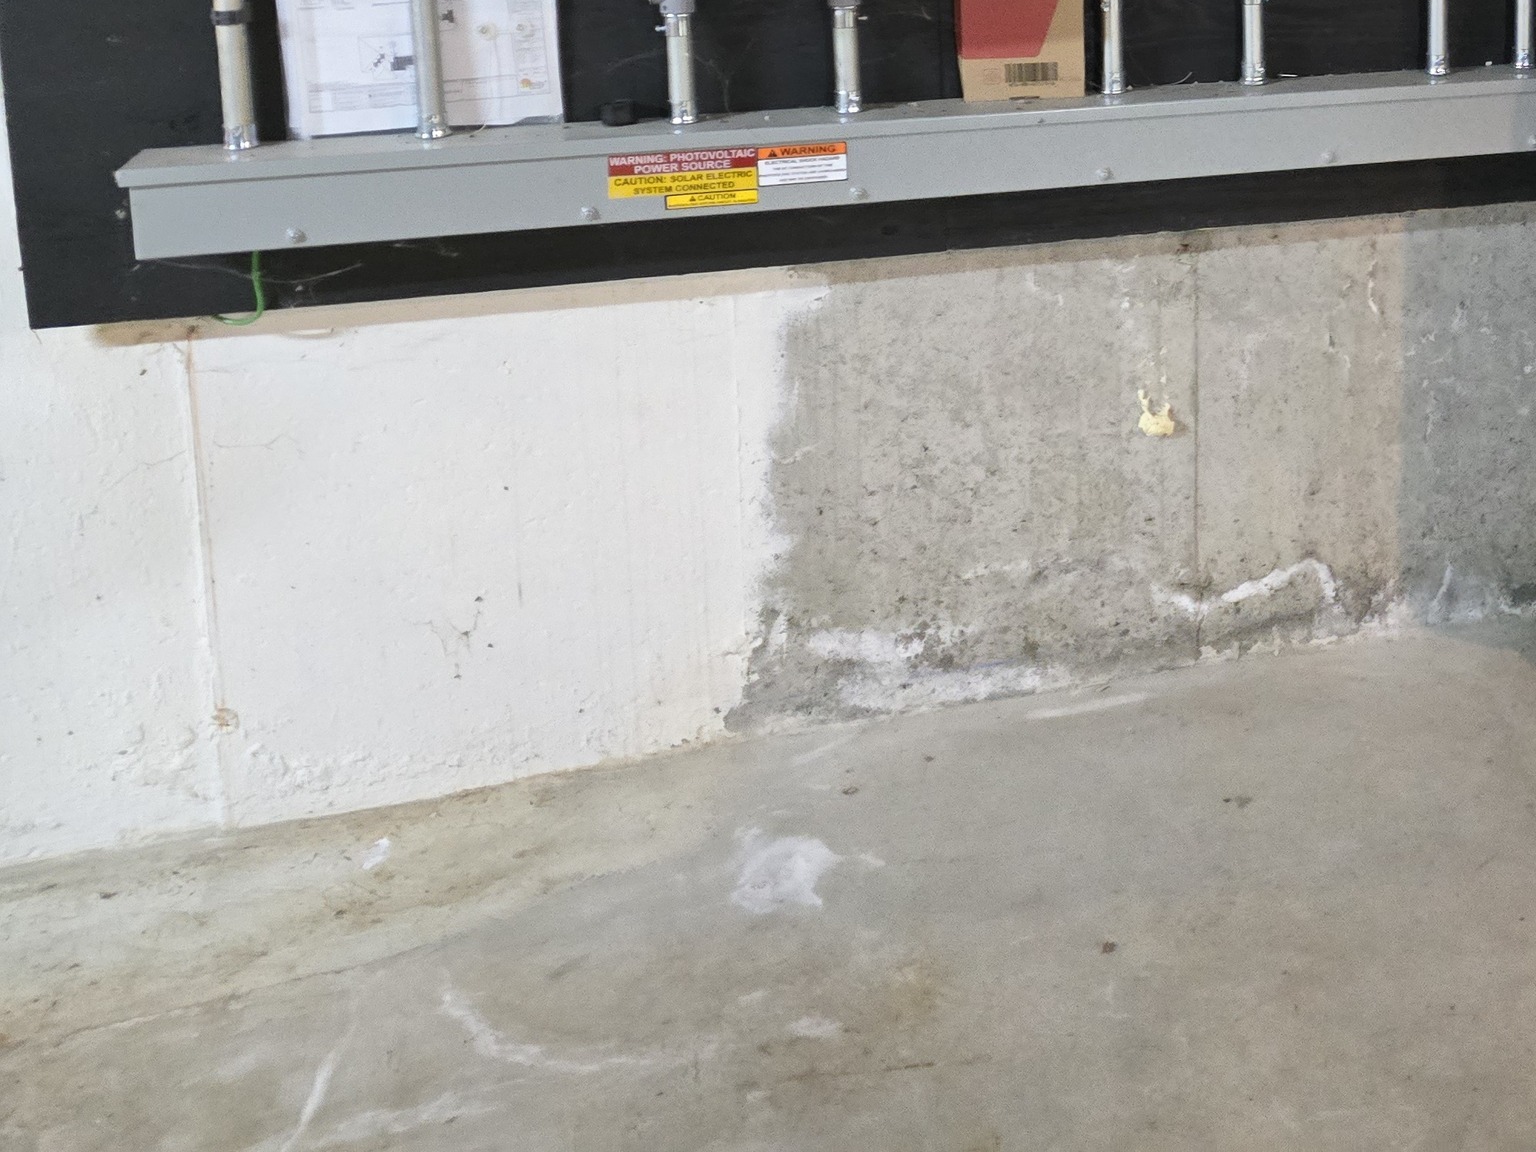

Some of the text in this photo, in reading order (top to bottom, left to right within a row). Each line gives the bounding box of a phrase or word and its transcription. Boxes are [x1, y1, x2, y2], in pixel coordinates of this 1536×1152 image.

[609, 148, 755, 166] WARNING: PHOTOVOLTAIC
[779, 144, 837, 156] WARNING
[634, 159, 731, 174] POWER SOURCE
[614, 170, 753, 187] CAUTION: SOLAR ELECTRIC
[633, 181, 735, 195] SYSTEM CONNECTED
[697, 193, 736, 201] CAUTION
